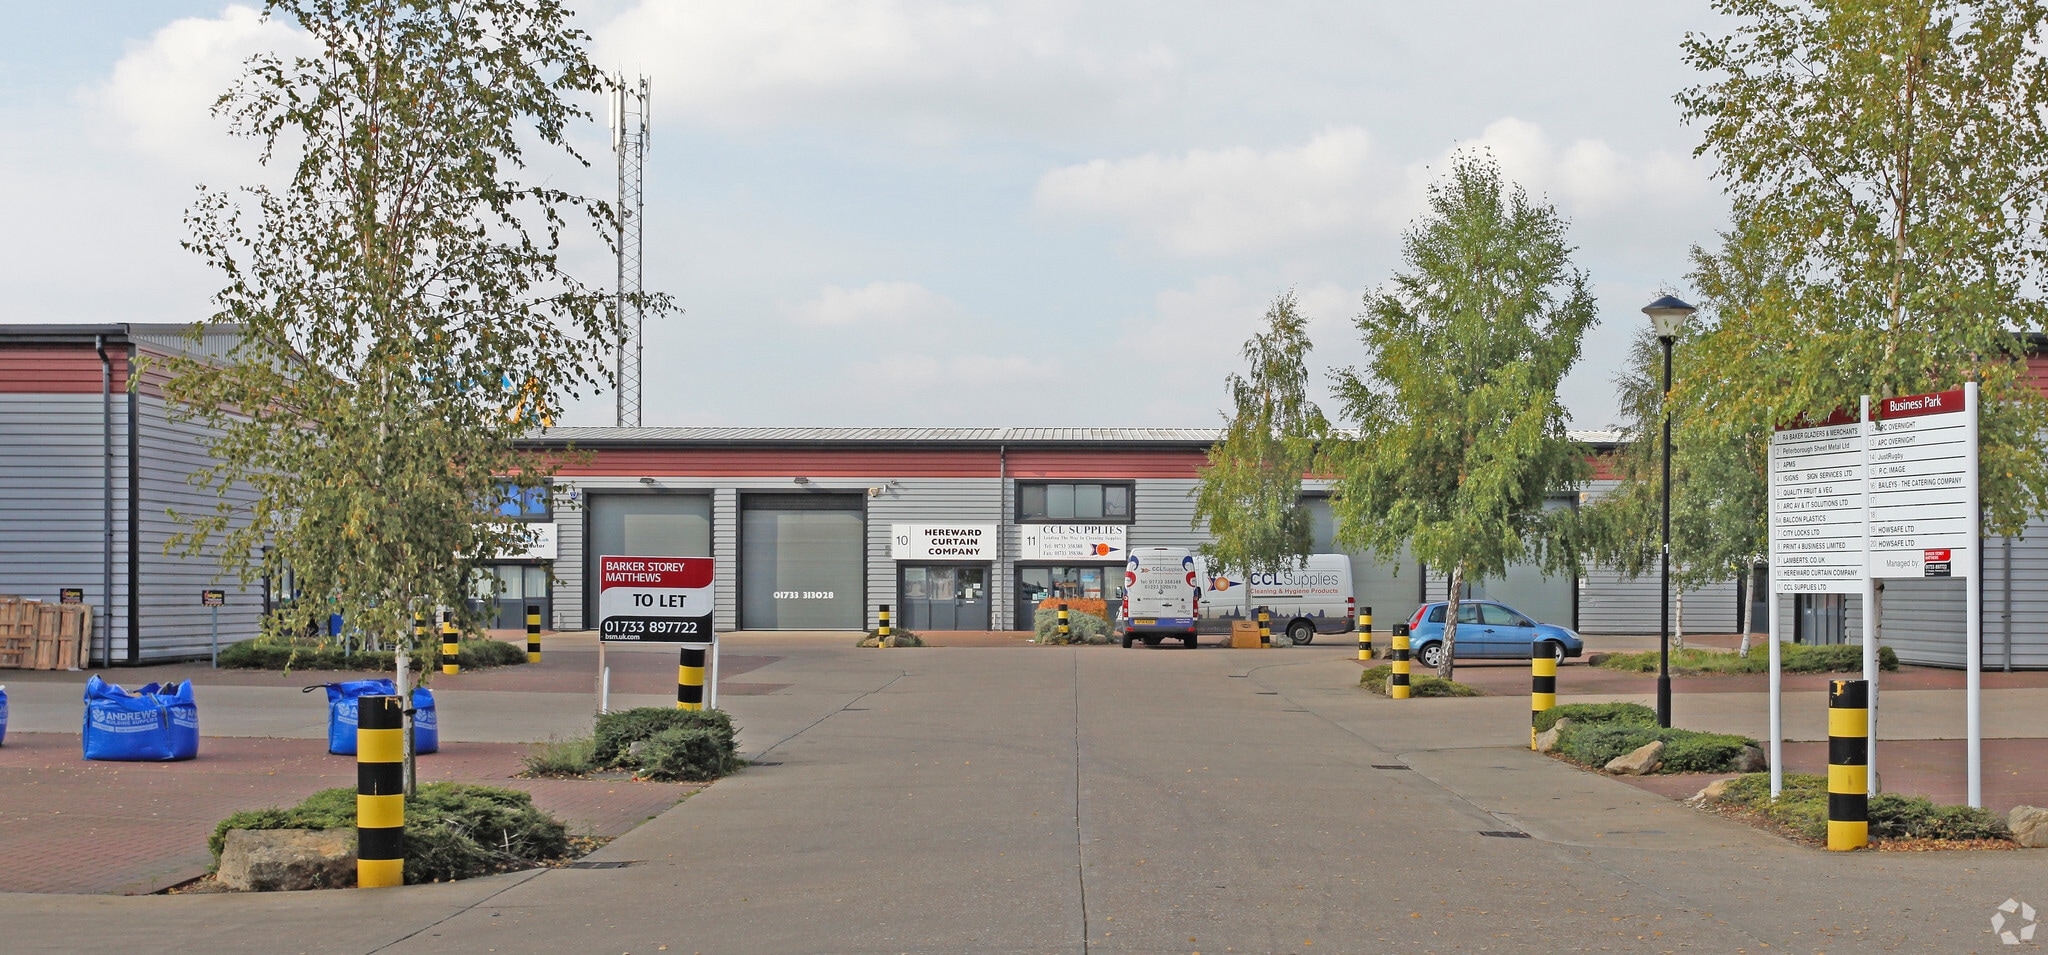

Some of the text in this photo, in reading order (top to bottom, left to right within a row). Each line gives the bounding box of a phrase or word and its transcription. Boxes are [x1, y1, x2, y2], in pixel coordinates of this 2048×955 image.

[1890, 394, 1942, 412] Business Park
[1888, 421, 1916, 431] OVERNIGHT
[1789, 432, 1804, 440] BAKER
[1804, 430, 1825, 439] GLAZIERS
[1830, 427, 1858, 436] MERCHANTS
[1888, 436, 1916, 445] OVERNIGHT
[1782, 446, 1813, 455] Peterborough
[1814, 444, 1828, 452] Sheet
[1878, 452, 1904, 460] JustRugby
[1819, 471, 1842, 479] SERVICES
[1878, 481, 1898, 489] BAILEYS
[1911, 478, 1936, 486] CATERING
[1937, 477, 1962, 485] COMPANY
[1783, 488, 1803, 496] QUALITY
[1811, 500, 1838, 508] SOLUTIONS
[1043, 525, 1123, 535] CCL SUPPLIES
[896, 535, 909, 546] 10
[1027, 536, 1036, 546] 11
[1663, 543, 1669, 554] 1
[1801, 542, 1826, 550] BUSINESS
[606, 561, 685, 572] BARKER STOREY
[1886, 560, 1910, 569] Managed
[1911, 560, 1919, 568] by
[605, 572, 661, 583] MATTHEWS
[773, 591, 834, 599] 01733 313028
[633, 593, 687, 608] TO LET
[605, 621, 698, 634] 01733 897722
[106, 709, 157, 720] ANDREWS
[132, 717, 158, 725] SUPPLIES
